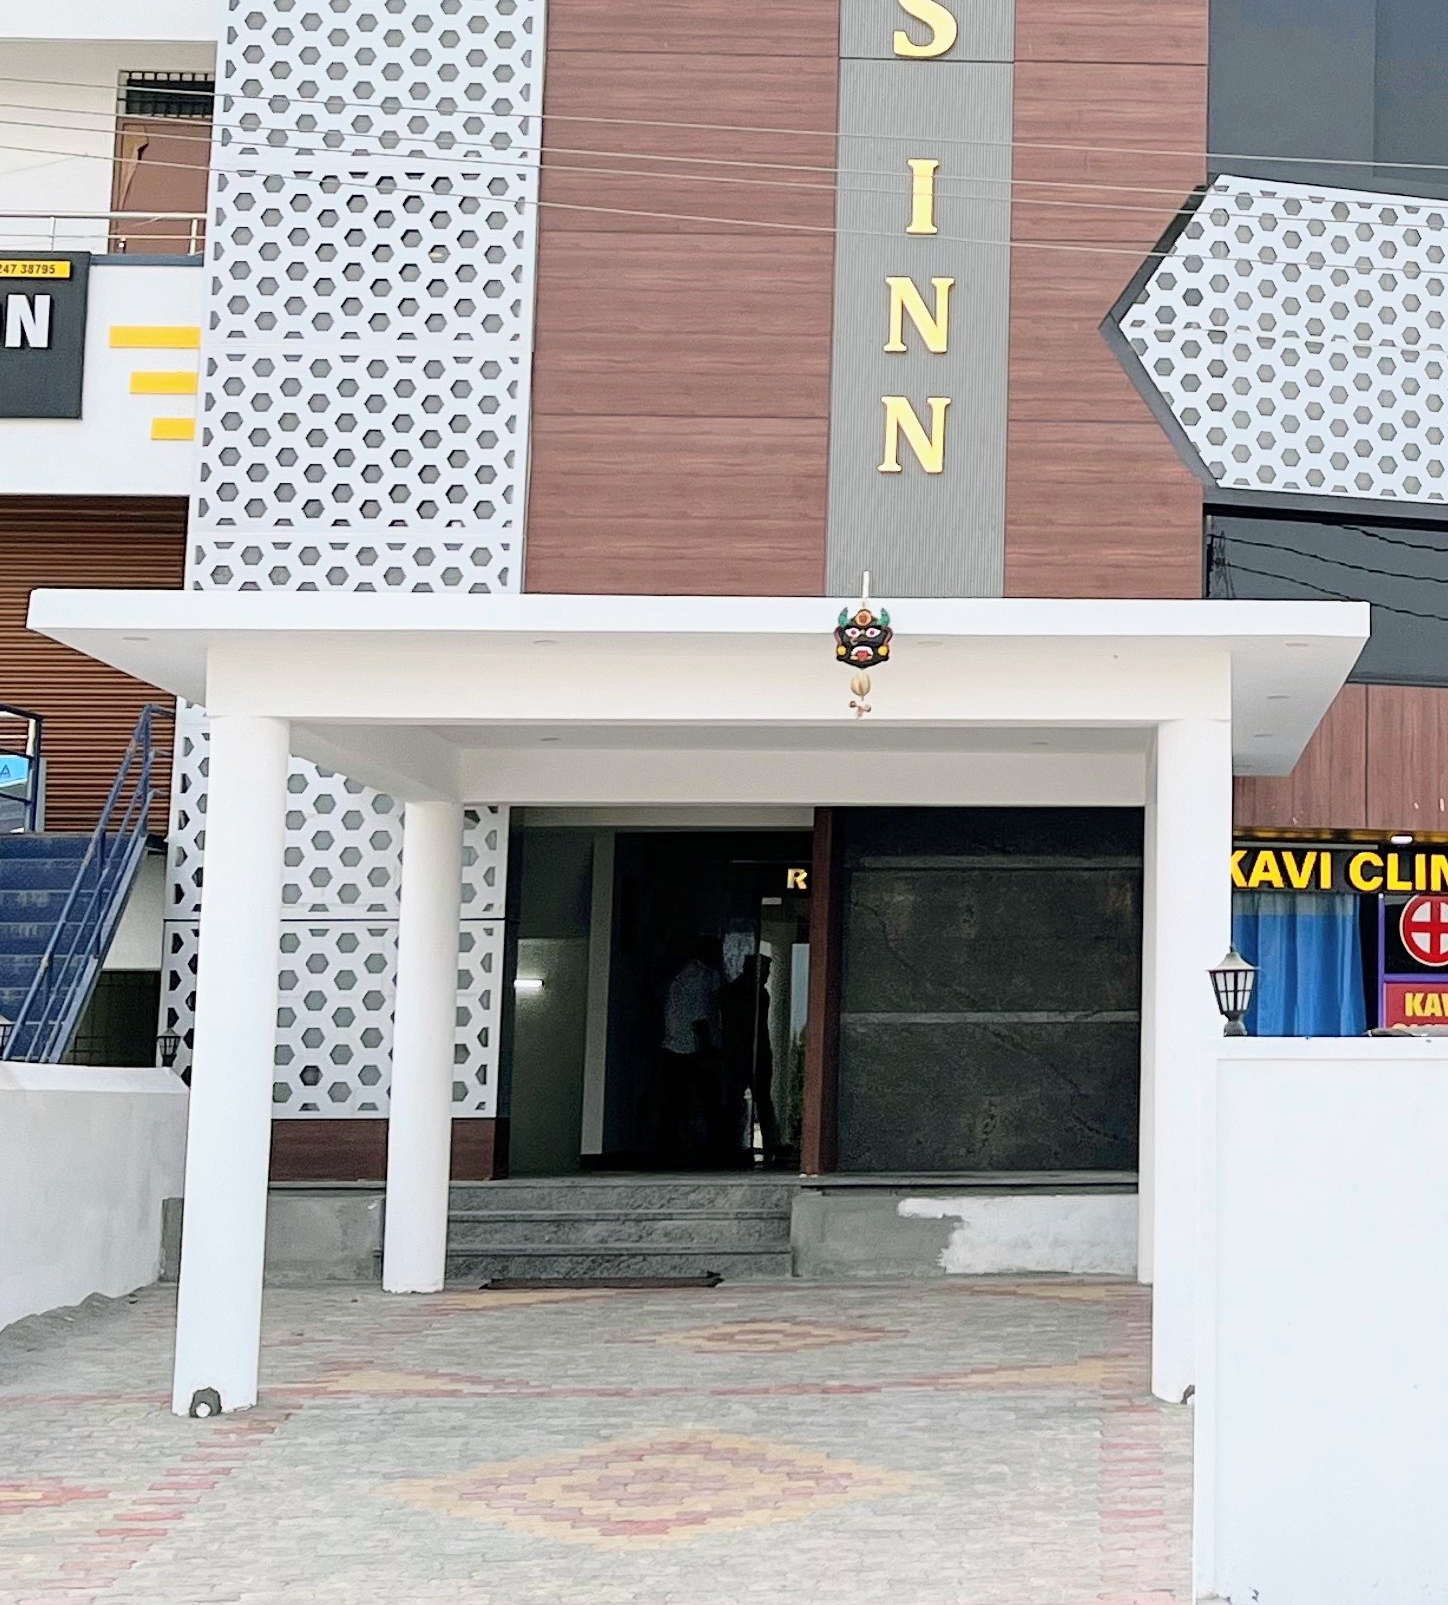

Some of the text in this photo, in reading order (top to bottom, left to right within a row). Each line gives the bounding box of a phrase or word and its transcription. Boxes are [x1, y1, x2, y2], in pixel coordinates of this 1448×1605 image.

[20, 263, 56, 275] 38795
[877, 157, 955, 475] INN
[1231, 849, 1332, 890] KAVI
